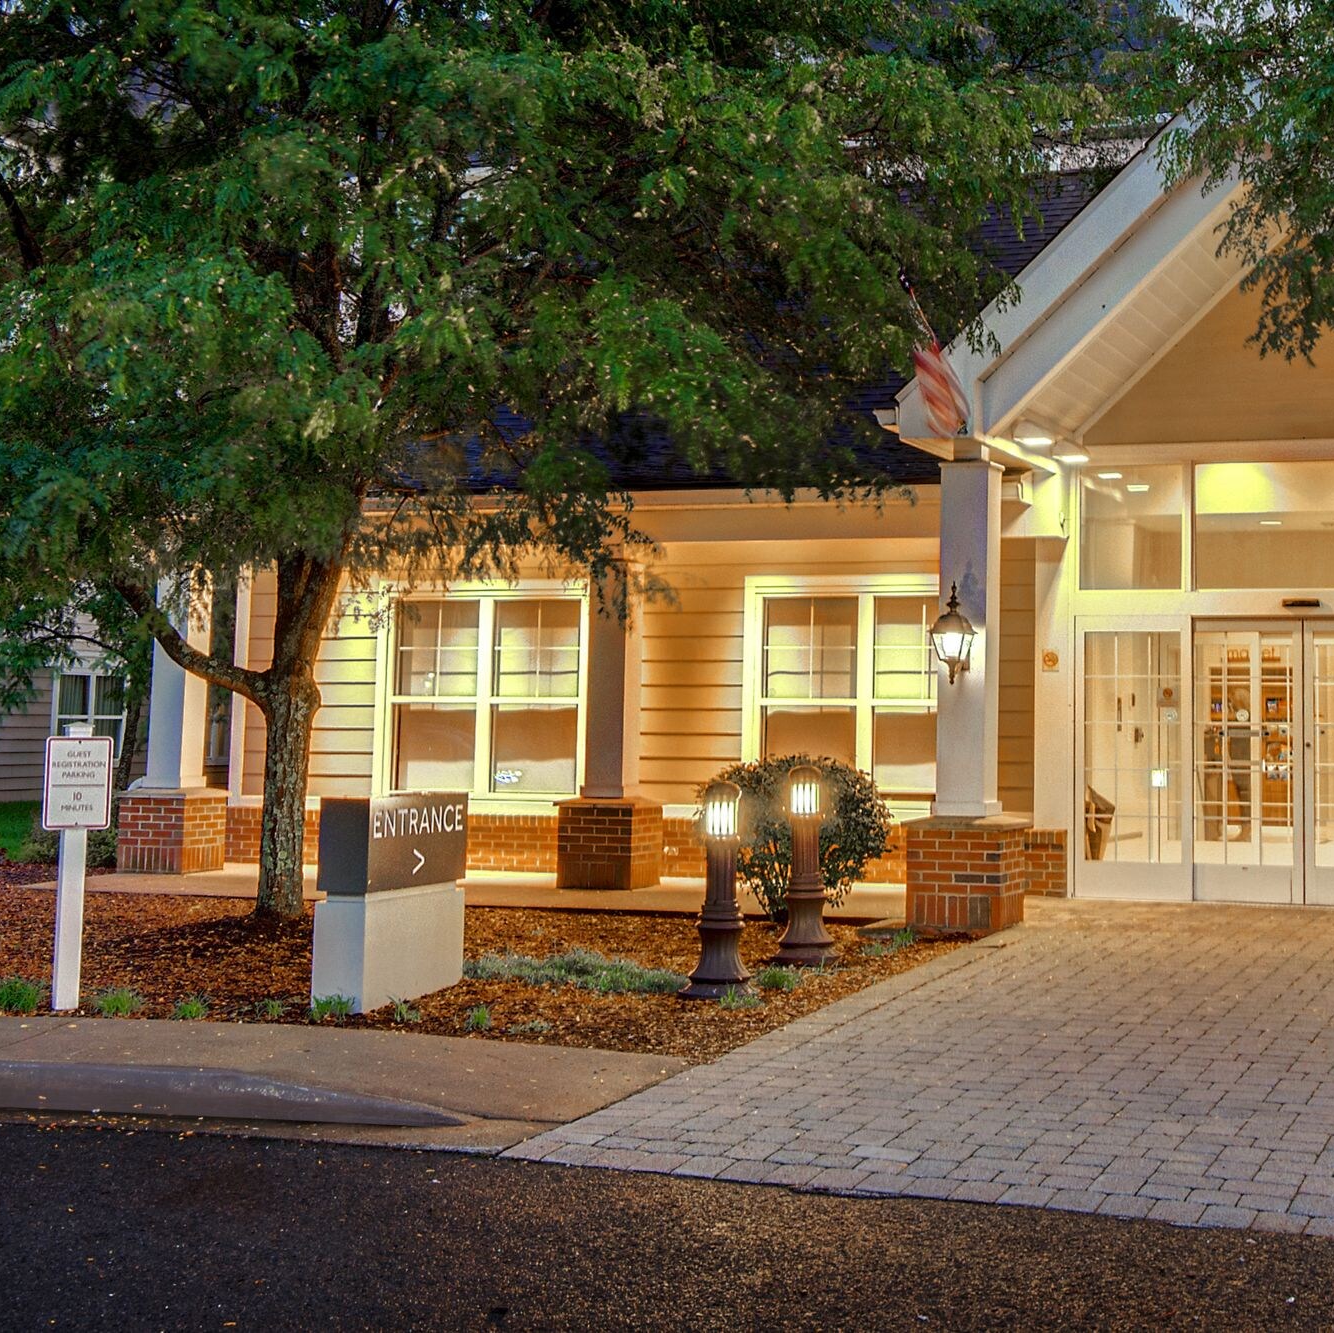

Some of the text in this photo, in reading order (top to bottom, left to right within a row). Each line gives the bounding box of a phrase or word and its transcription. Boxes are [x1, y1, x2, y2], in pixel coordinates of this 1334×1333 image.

[1227, 646, 1275, 660] maet
[52, 760, 107, 769] REGISTRATION
[62, 771, 95, 779] PARKING
[73, 791, 83, 801] 10
[60, 804, 93, 812] MINUTES
[373, 804, 464, 839] ENTRANCE
